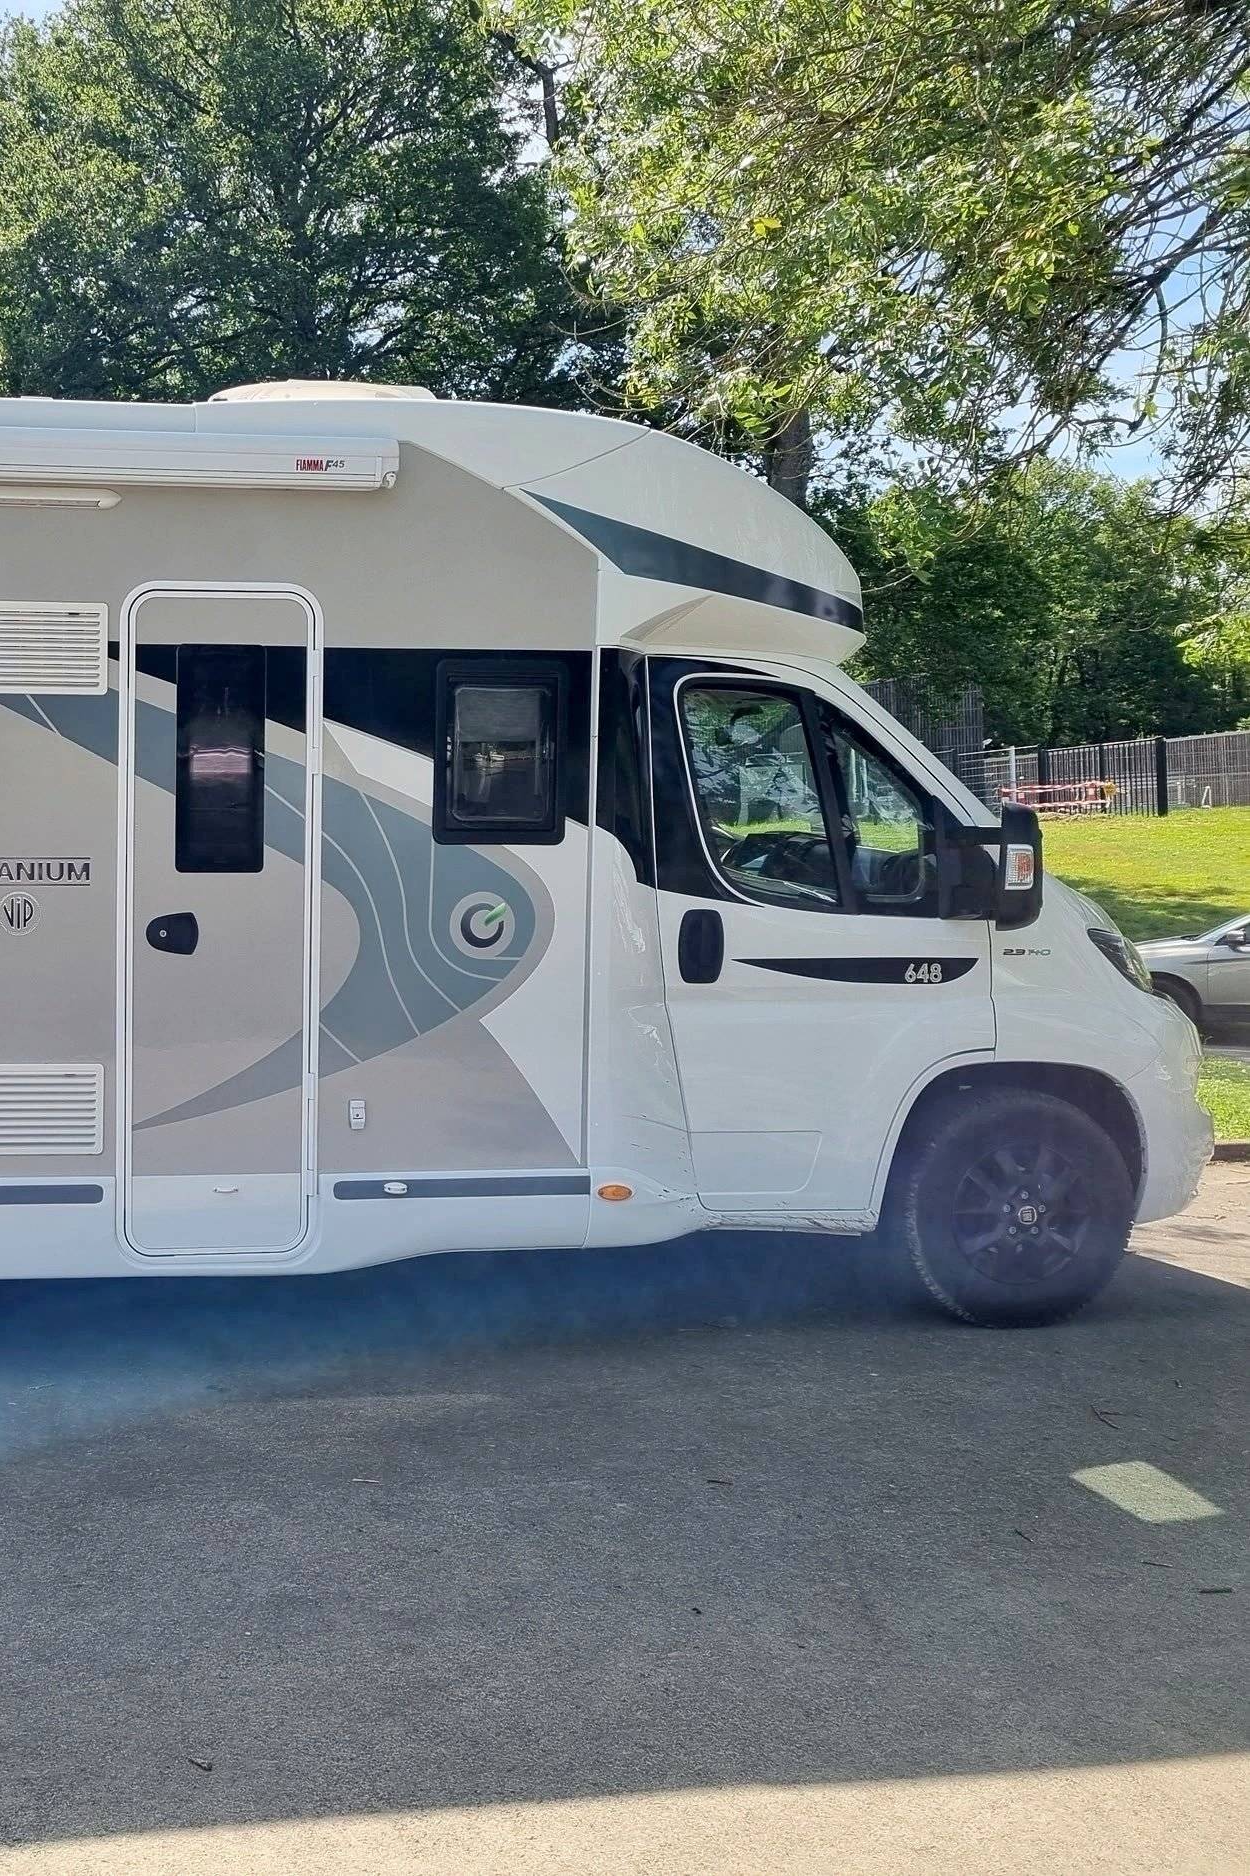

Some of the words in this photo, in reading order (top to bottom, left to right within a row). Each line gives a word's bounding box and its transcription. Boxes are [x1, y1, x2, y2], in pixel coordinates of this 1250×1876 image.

[296, 459, 324, 471] FIAMMA
[325, 459, 345, 471] F45
[904, 963, 943, 983] 648
